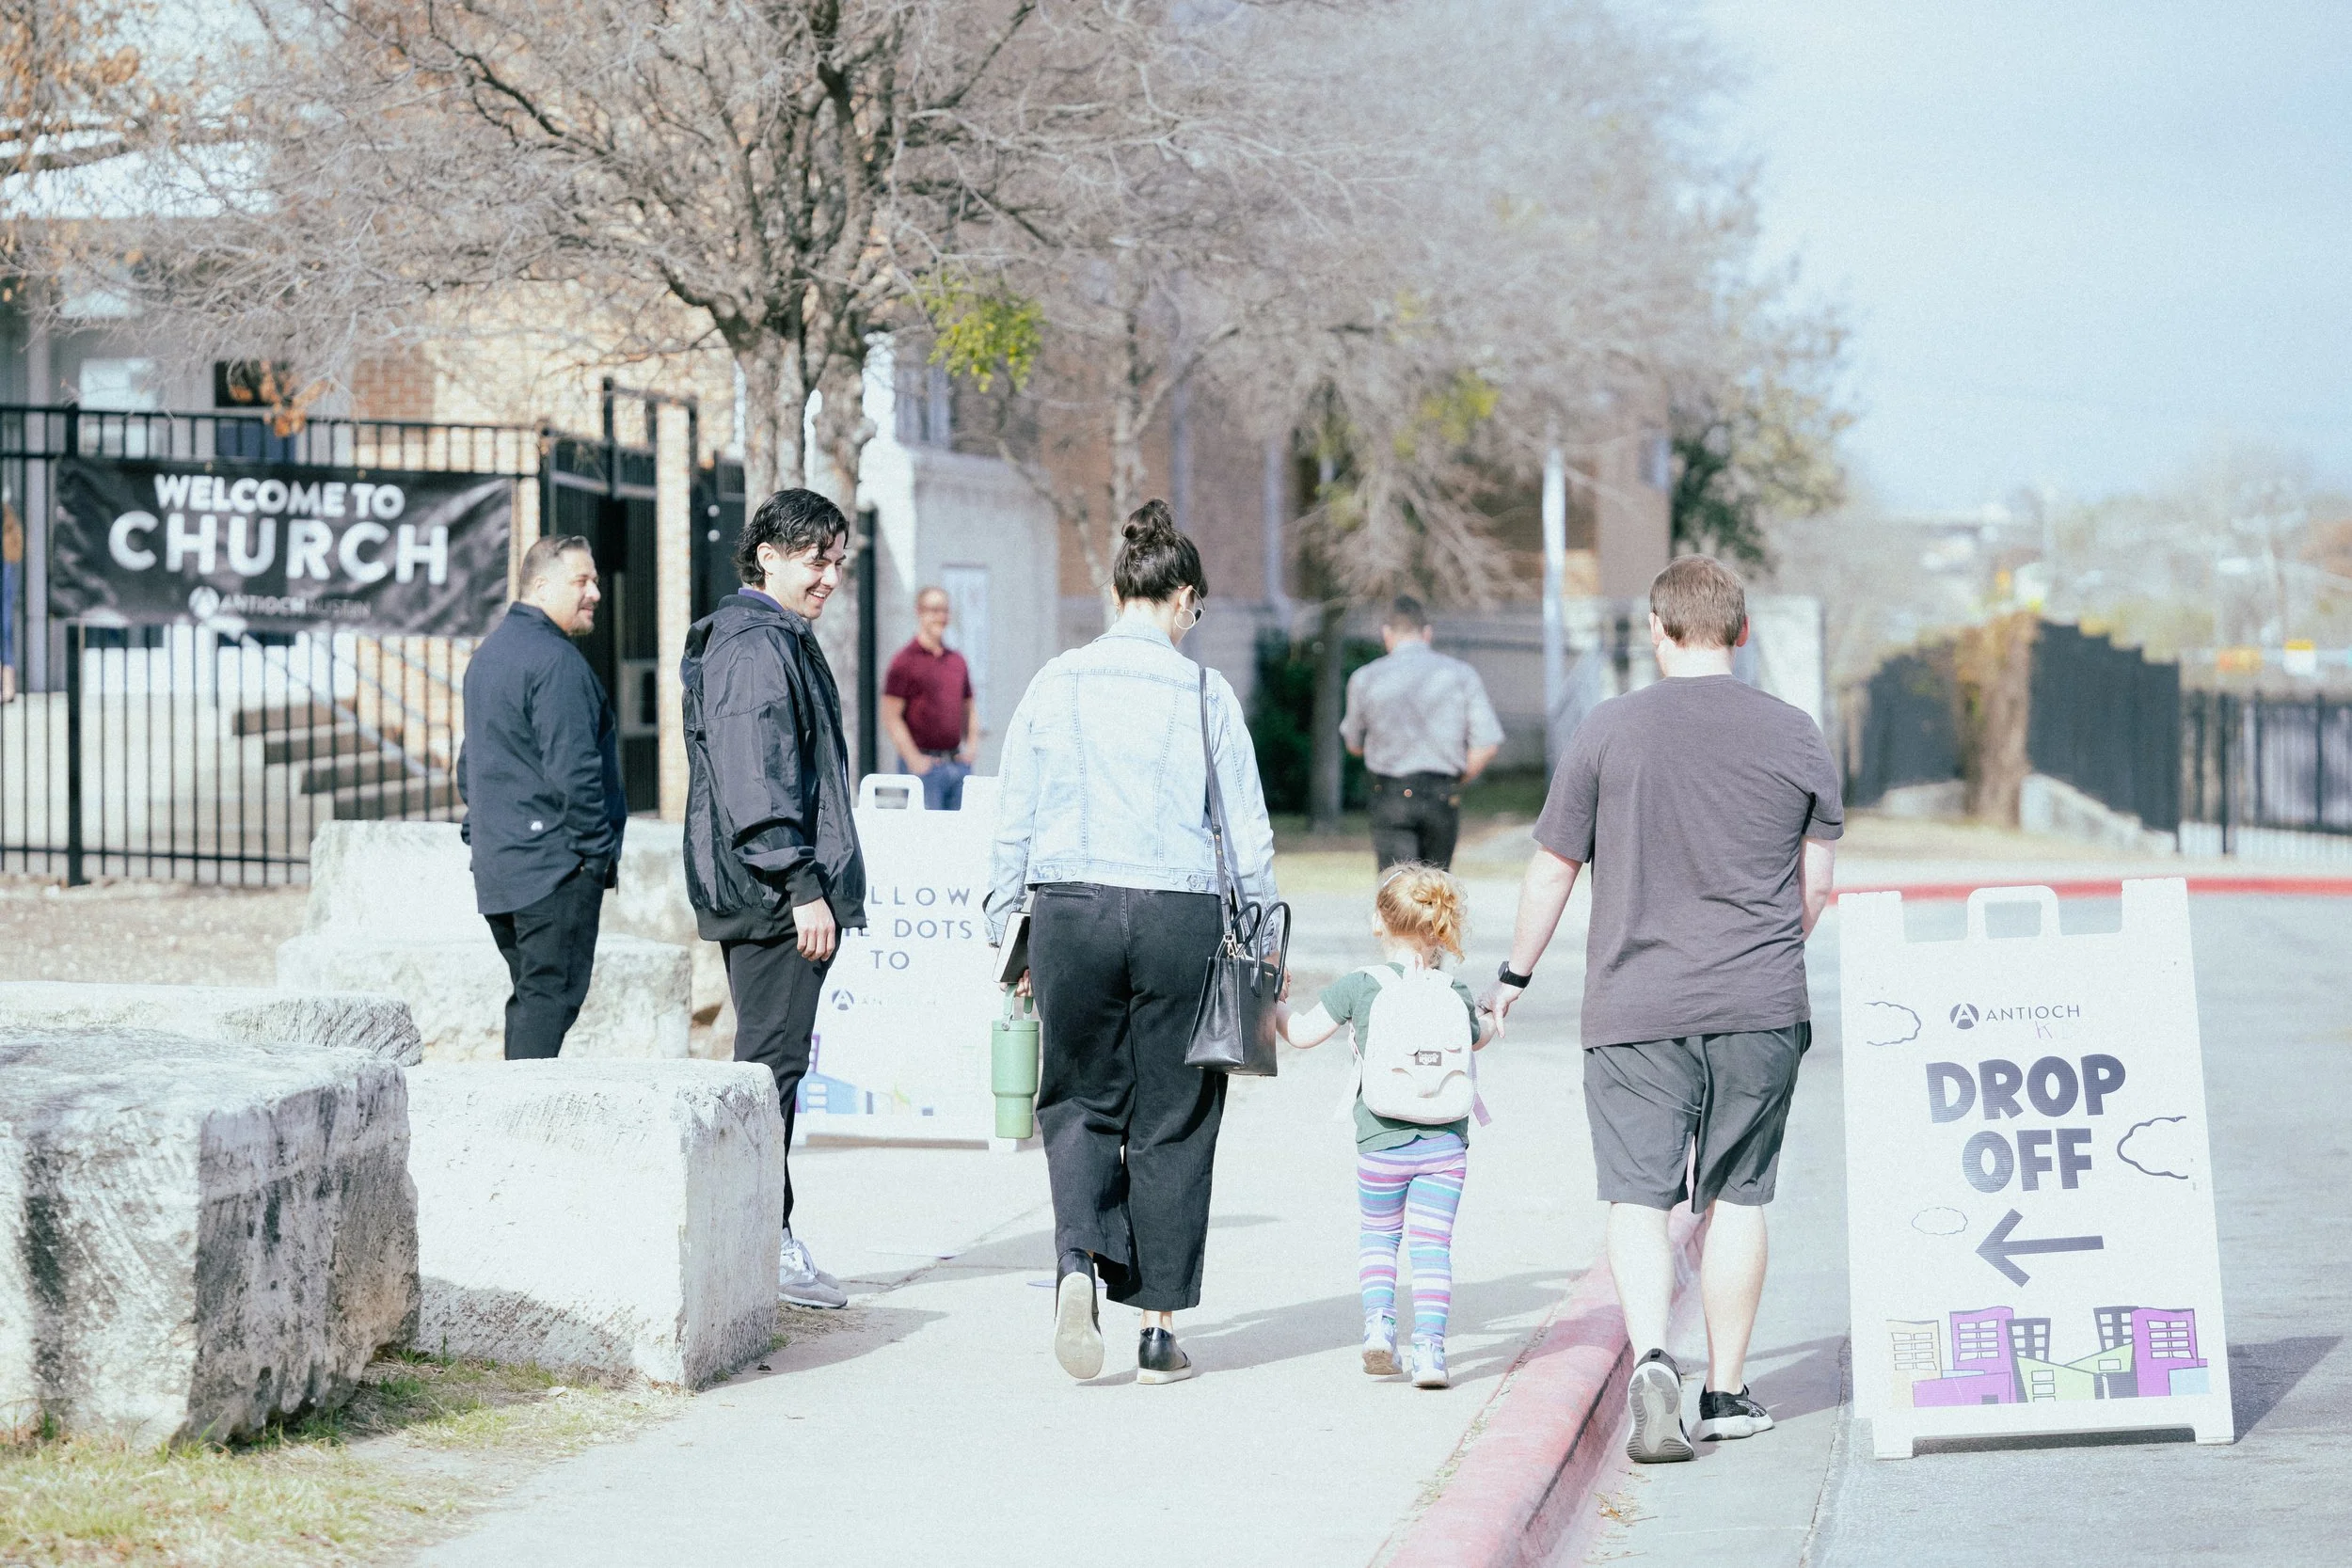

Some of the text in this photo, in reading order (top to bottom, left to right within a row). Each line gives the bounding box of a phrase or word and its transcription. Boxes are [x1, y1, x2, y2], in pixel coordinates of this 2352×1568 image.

[154, 474, 405, 520] WELCOME TO
[108, 510, 449, 585] CHURCH
[870, 885, 970, 907] LLOW
[895, 918, 973, 940] DOTS
[870, 949, 910, 971] TO
[1986, 1005, 2080, 1022] ANTIOCH
[1925, 1053, 2126, 1124] DROP
[1962, 1128, 2092, 1194] OFF
